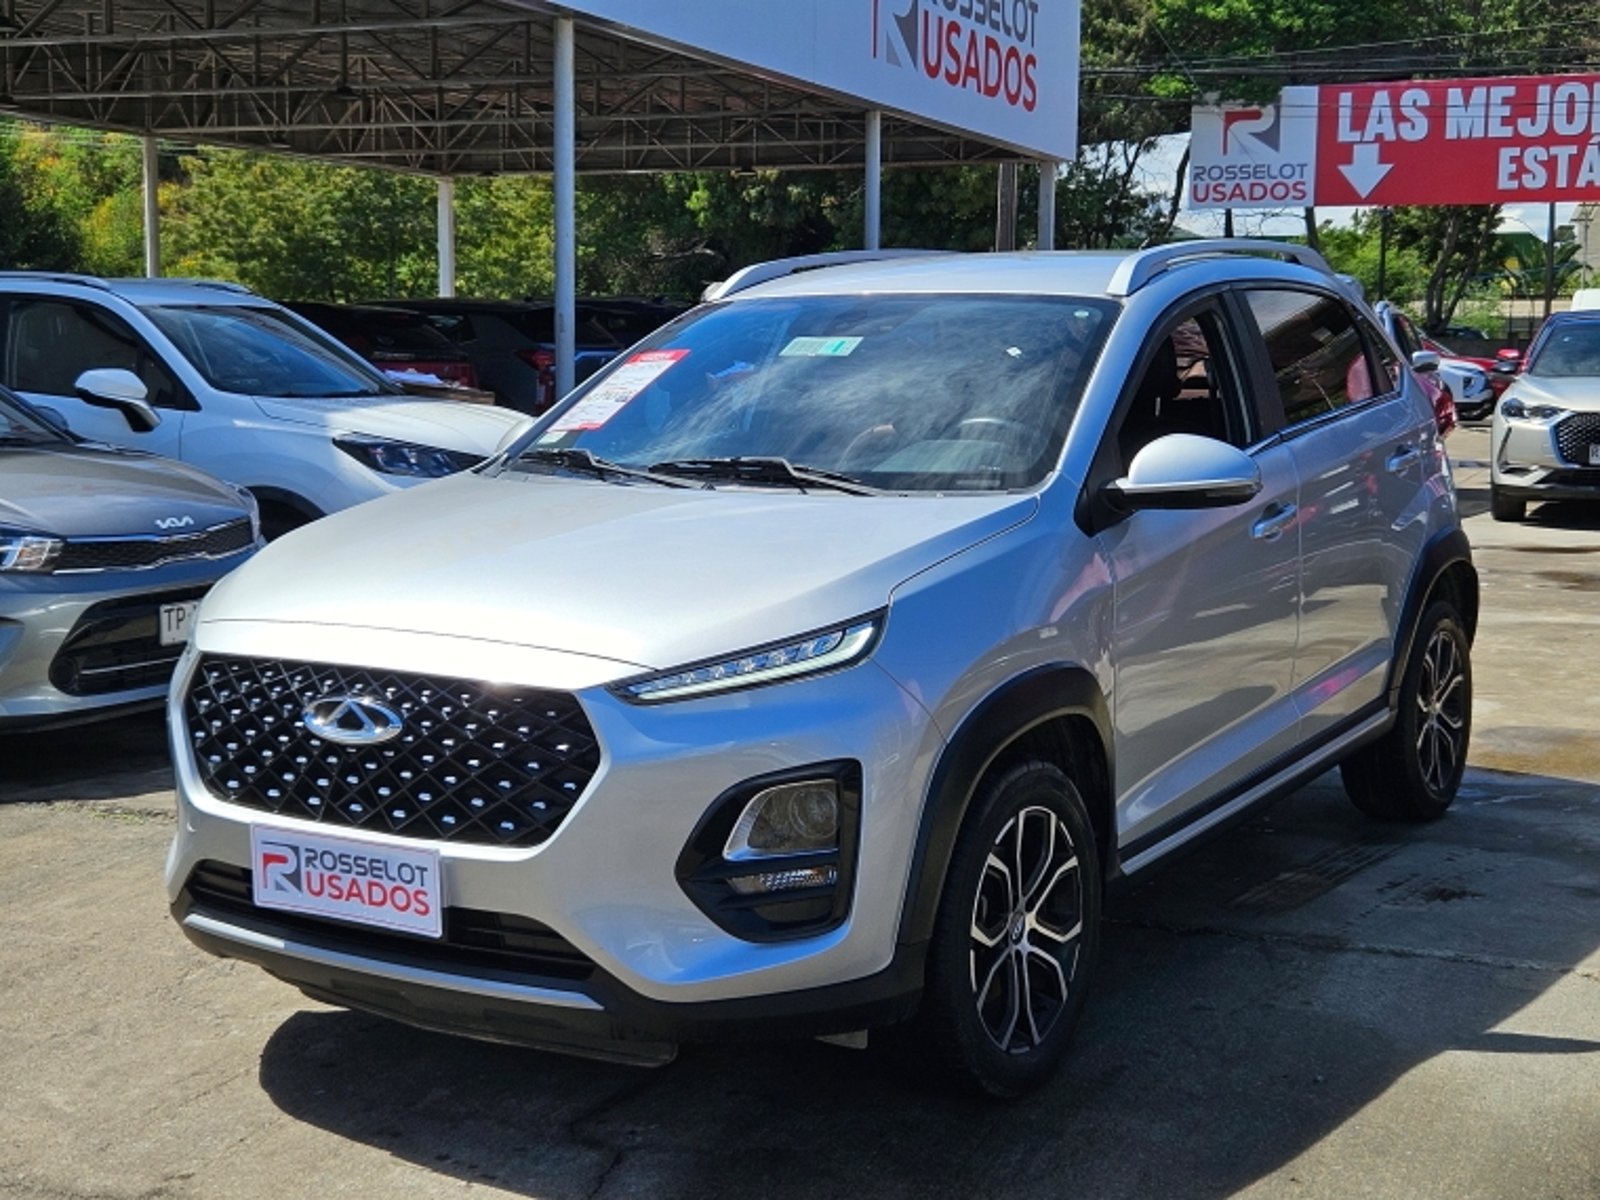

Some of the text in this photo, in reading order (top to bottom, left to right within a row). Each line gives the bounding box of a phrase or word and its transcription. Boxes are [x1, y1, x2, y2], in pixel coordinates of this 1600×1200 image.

[923, 9, 1037, 112] USADOS
[1337, 81, 1600, 143] LAS MEJO
[1193, 163, 1308, 182] ROSSELOT
[1193, 181, 1307, 203] USADOS
[304, 847, 428, 887] ROSSELOT
[306, 871, 430, 916] USADOS
